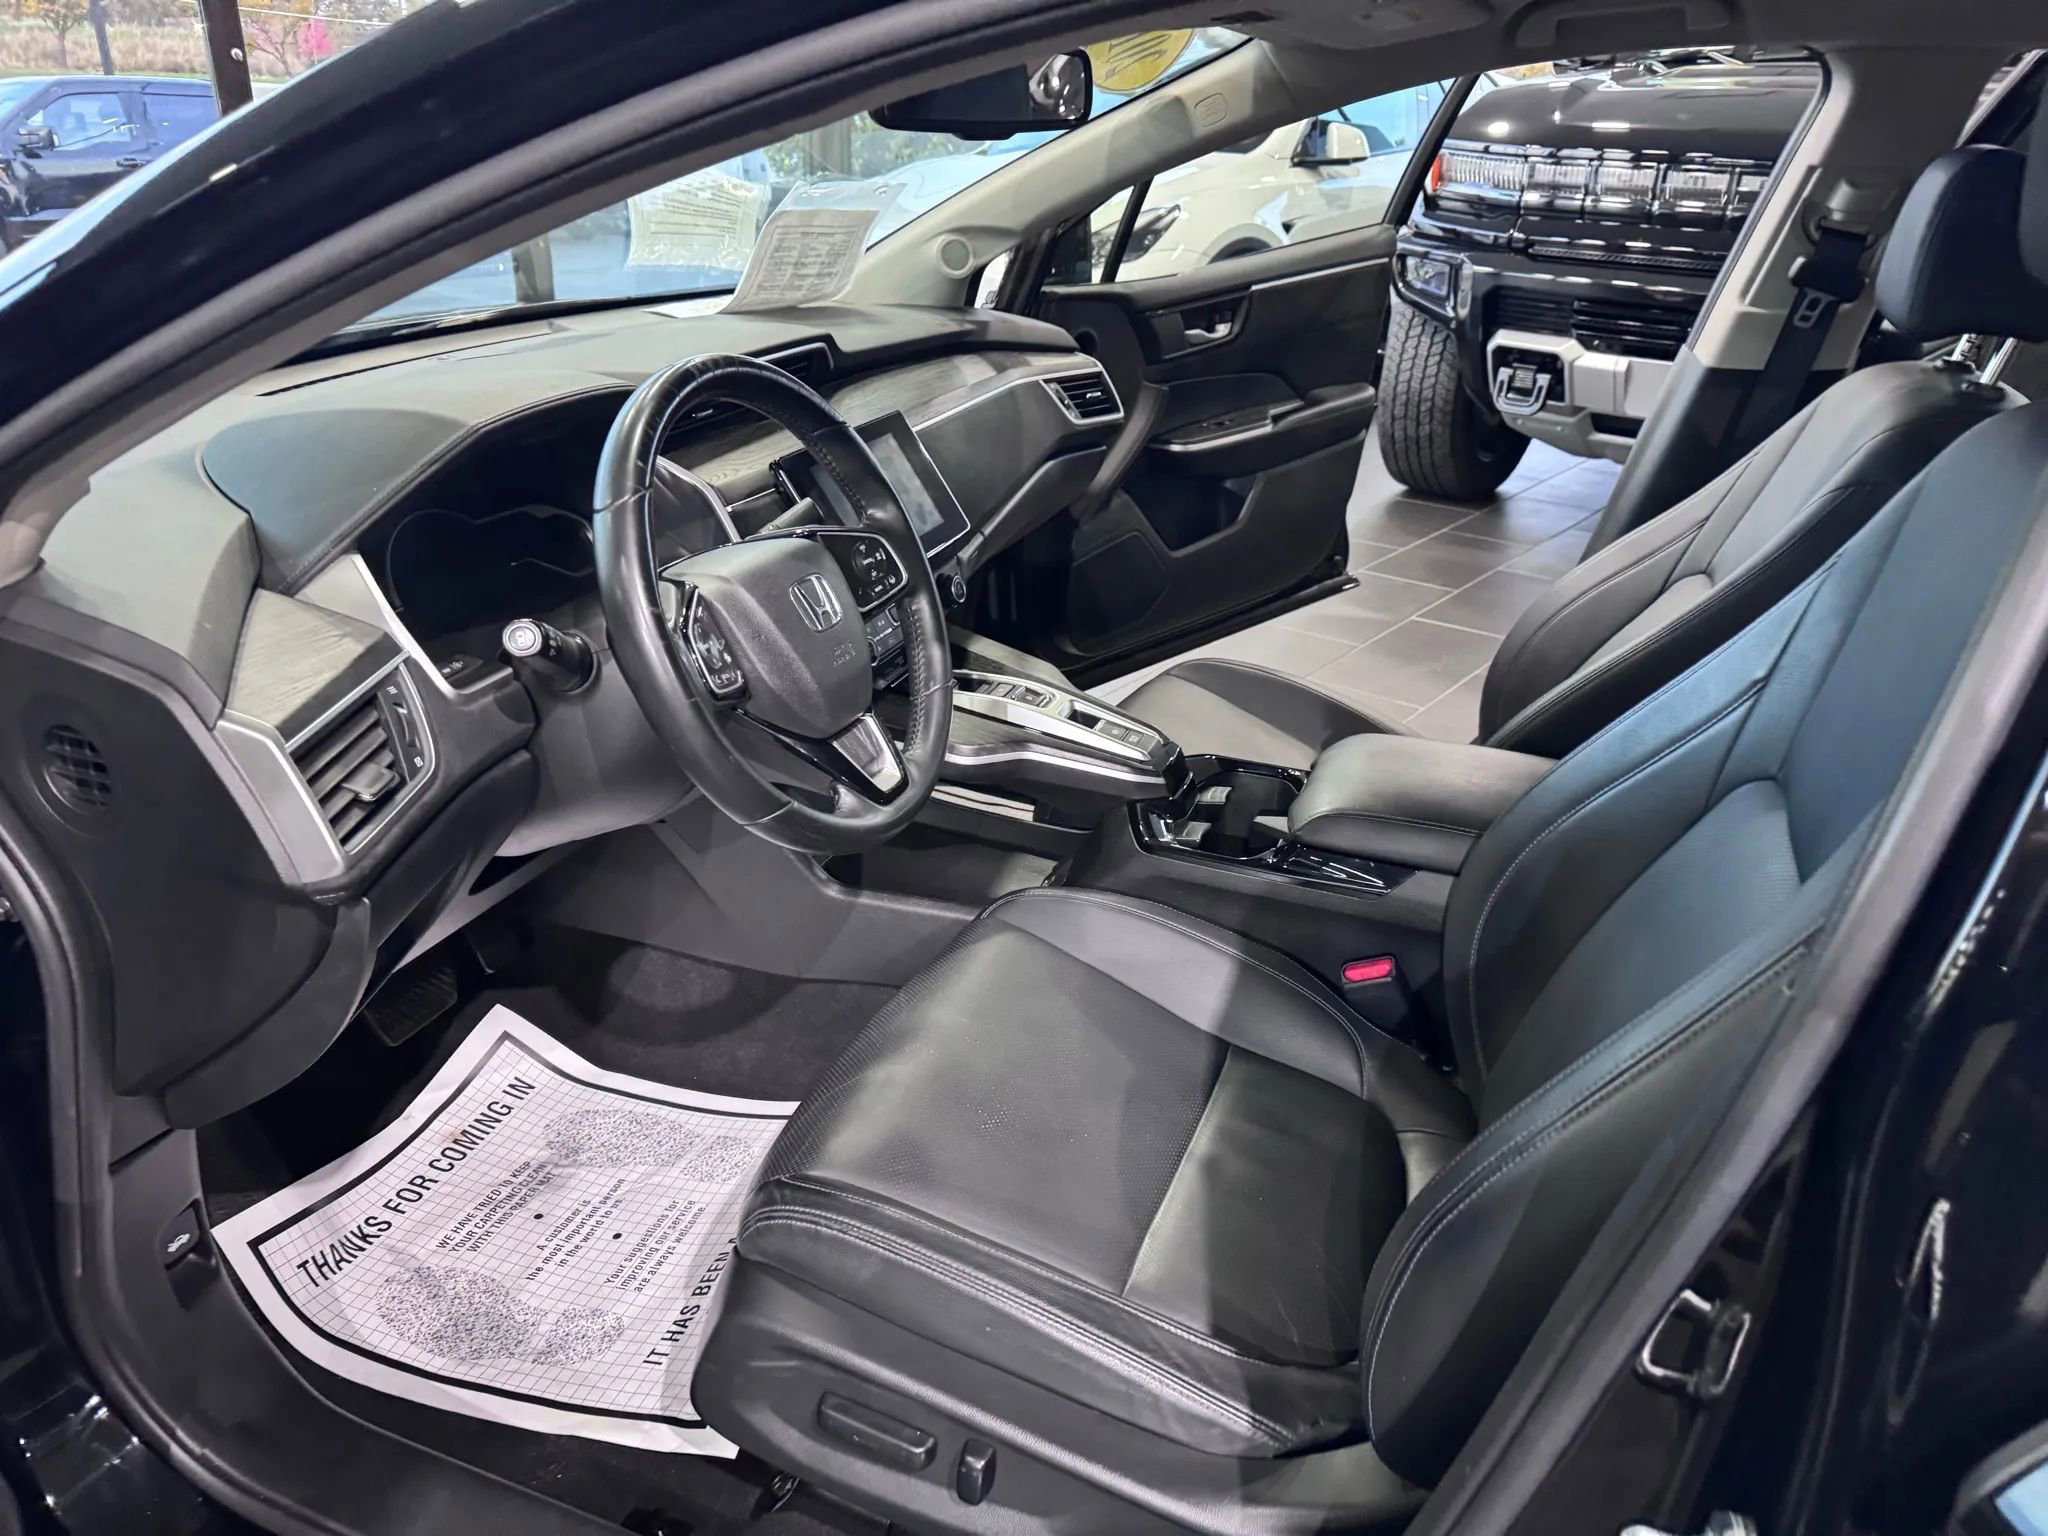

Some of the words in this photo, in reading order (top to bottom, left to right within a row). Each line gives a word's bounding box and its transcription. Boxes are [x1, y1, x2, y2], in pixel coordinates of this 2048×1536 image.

[296, 1215, 393, 1288] THANKS
[382, 1174, 439, 1215] FOR
[428, 1100, 515, 1173] COMING
[502, 1075, 536, 1101] IN
[435, 1233, 456, 1250] WE
[450, 1212, 478, 1234] HAVE
[472, 1188, 502, 1212] TRIED
[497, 1179, 514, 1190] TO
[509, 1160, 531, 1179] KEEP
[448, 1229, 479, 1253] YOUR
[474, 1186, 522, 1230] CARPETING
[518, 1163, 548, 1188] CLEAN
[466, 1230, 495, 1253] WITH
[490, 1211, 514, 1230] THIS
[509, 1186, 540, 1212] PAPER
[535, 1171, 557, 1188] MAT
[544, 1207, 583, 1243] customer
[577, 1199, 592, 1208] is
[525, 1266, 544, 1281] the
[541, 1243, 566, 1265] most
[561, 1205, 602, 1244] important
[598, 1178, 626, 1206] person
[554, 1257, 570, 1268] in
[564, 1244, 583, 1258] the
[579, 1219, 605, 1243] world
[599, 1210, 613, 1219] to
[603, 1264, 627, 1285] Your
[623, 1213, 670, 1263] suggestions
[663, 1200, 680, 1212] for
[615, 1246, 661, 1291] improving
[655, 1231, 671, 1245] our
[667, 1200, 696, 1230] service
[633, 1277, 651, 1293] are
[647, 1245, 677, 1276] always
[642, 1347, 670, 1366] IT
[660, 1304, 701, 1342] HAS
[691, 1251, 730, 1297] BEEN
